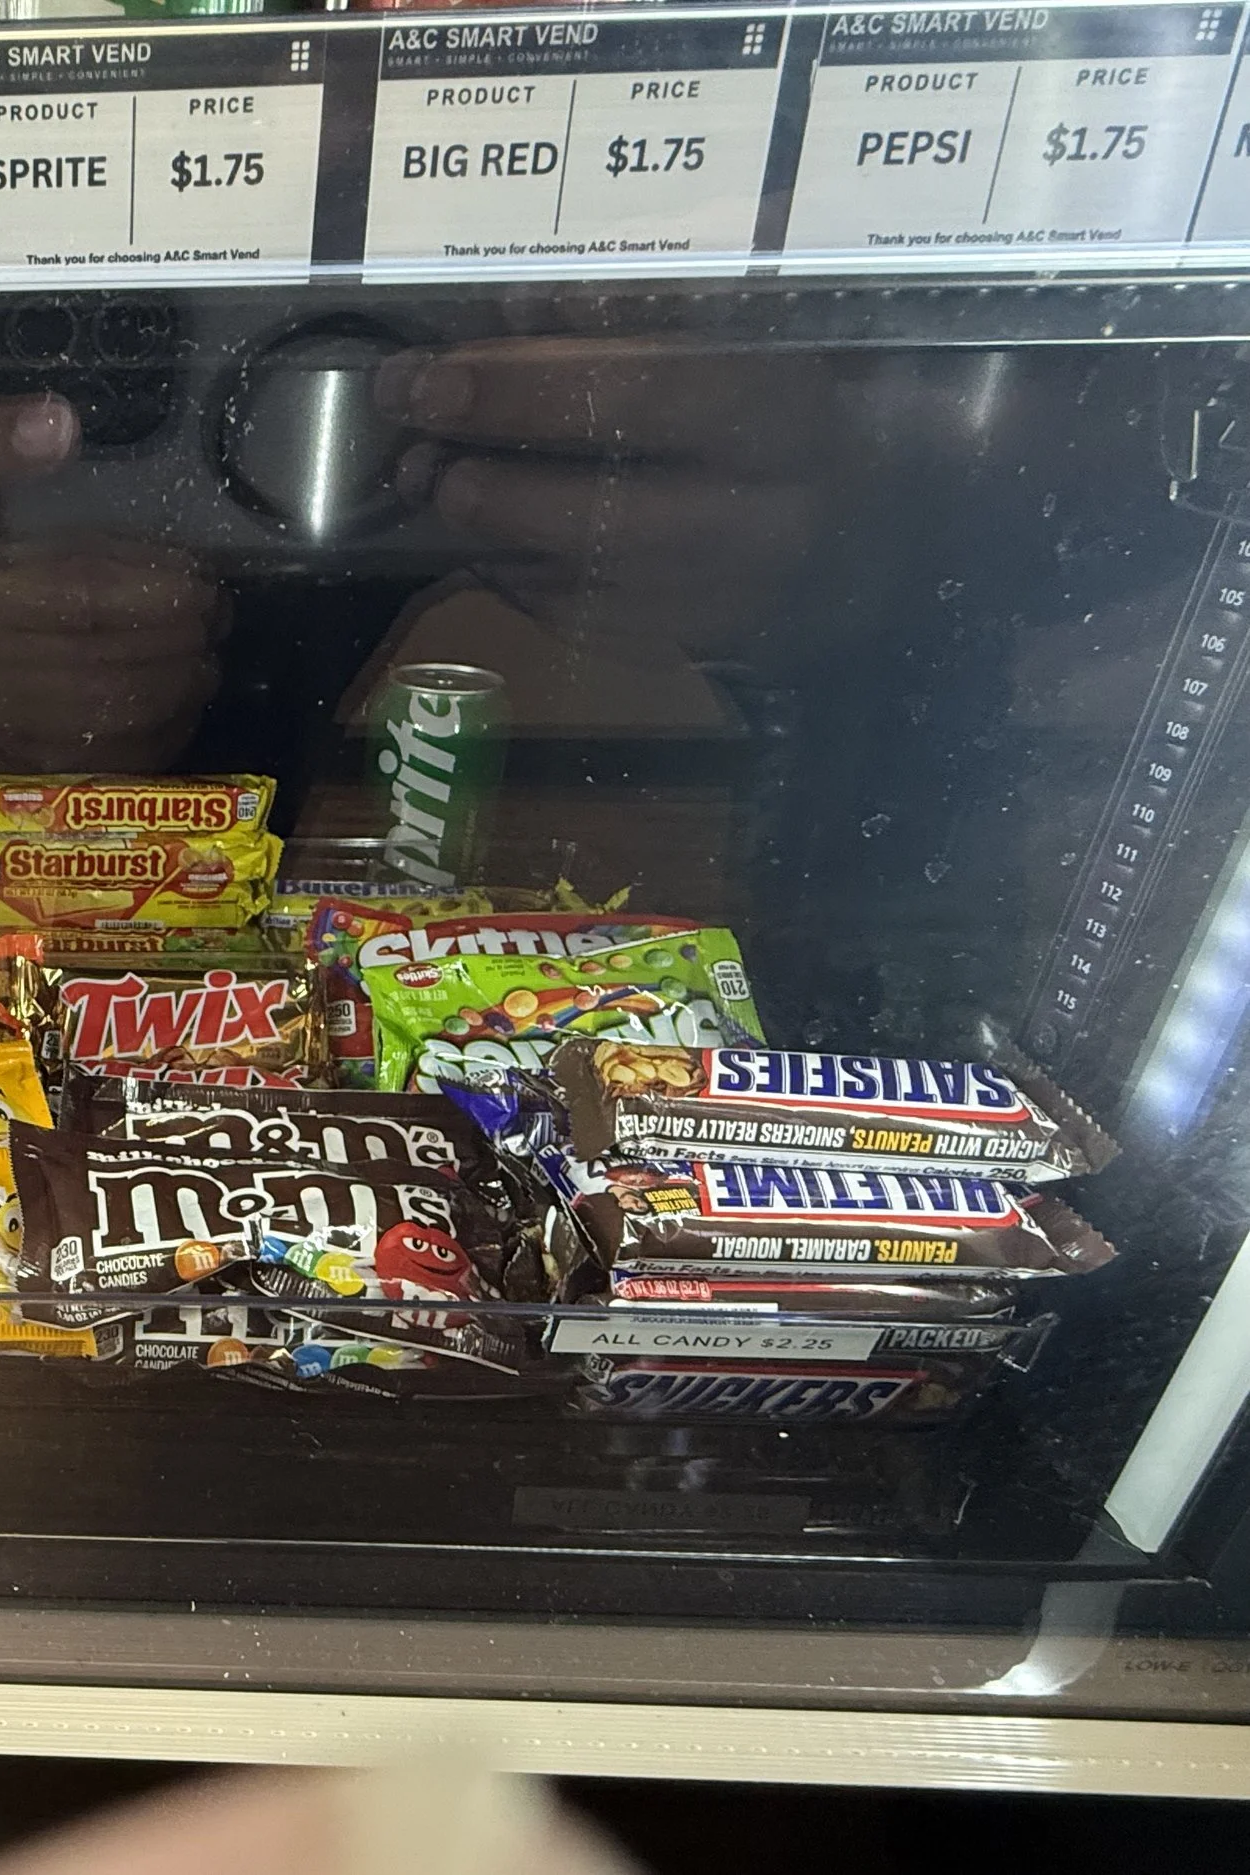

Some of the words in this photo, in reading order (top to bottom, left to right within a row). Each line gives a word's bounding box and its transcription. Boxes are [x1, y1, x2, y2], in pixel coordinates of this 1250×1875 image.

[832, 14, 883, 36] A&C
[891, 10, 973, 33] SMART
[983, 8, 1049, 30] VEND
[389, 29, 438, 50] A&C
[446, 26, 526, 49] SMART
[535, 24, 598, 45] VEND
[8, 44, 85, 65] SMART
[92, 43, 151, 63] VEND
[865, 72, 978, 92] PRODUCT
[1075, 67, 1149, 86] PRICE
[427, 86, 536, 106] PRODUCT
[631, 81, 701, 99] PRICE
[190, 96, 254, 115] PRICE
[857, 128, 972, 166] PEPSI
[1042, 121, 1149, 165] $1.75
[403, 144, 469, 179] BIG
[480, 142, 559, 176] RED
[606, 135, 706, 177] $1.75
[171, 151, 264, 192] $1.75
[27, 254, 60, 265] Thank
[64, 256, 85, 266] you
[89, 253, 105, 263] for
[107, 251, 161, 264] choosing
[163, 251, 190, 261] A&C
[193, 250, 227, 261] Smart
[230, 249, 260, 259] Vend
[1219, 587, 1245, 606] 105
[1201, 633, 1226, 653] 106
[1182, 678, 1207, 697] 107
[1165, 721, 1189, 741] 108
[1148, 763, 1172, 782] 109
[69, 792, 228, 829] Starburst
[1131, 803, 1155, 823] 110
[1116, 843, 1138, 862] 111
[8, 848, 162, 880] Starburst
[1100, 881, 1123, 901] 112
[1085, 918, 1108, 938] 113
[1070, 954, 1092, 974] 114
[1056, 990, 1078, 1011] 115
[60, 969, 289, 1060] Twix
[715, 1049, 1016, 1109] SATISFIES
[699, 1118, 758, 1140] REALLY
[760, 1122, 847, 1148] SNICKERS
[674, 1147, 726, 1160] Facts
[934, 1134, 983, 1157] WITH
[984, 1138, 1050, 1160] ACKED
[711, 1236, 783, 1259] NOUGAT.
[96, 1253, 165, 1273] CHOCOLATE
[98, 1270, 149, 1288] CANDIES
[592, 1333, 642, 1345] ALL
[653, 1334, 752, 1348] CANDY
[760, 1336, 835, 1350] $2.25
[890, 1329, 990, 1349] PACKED
